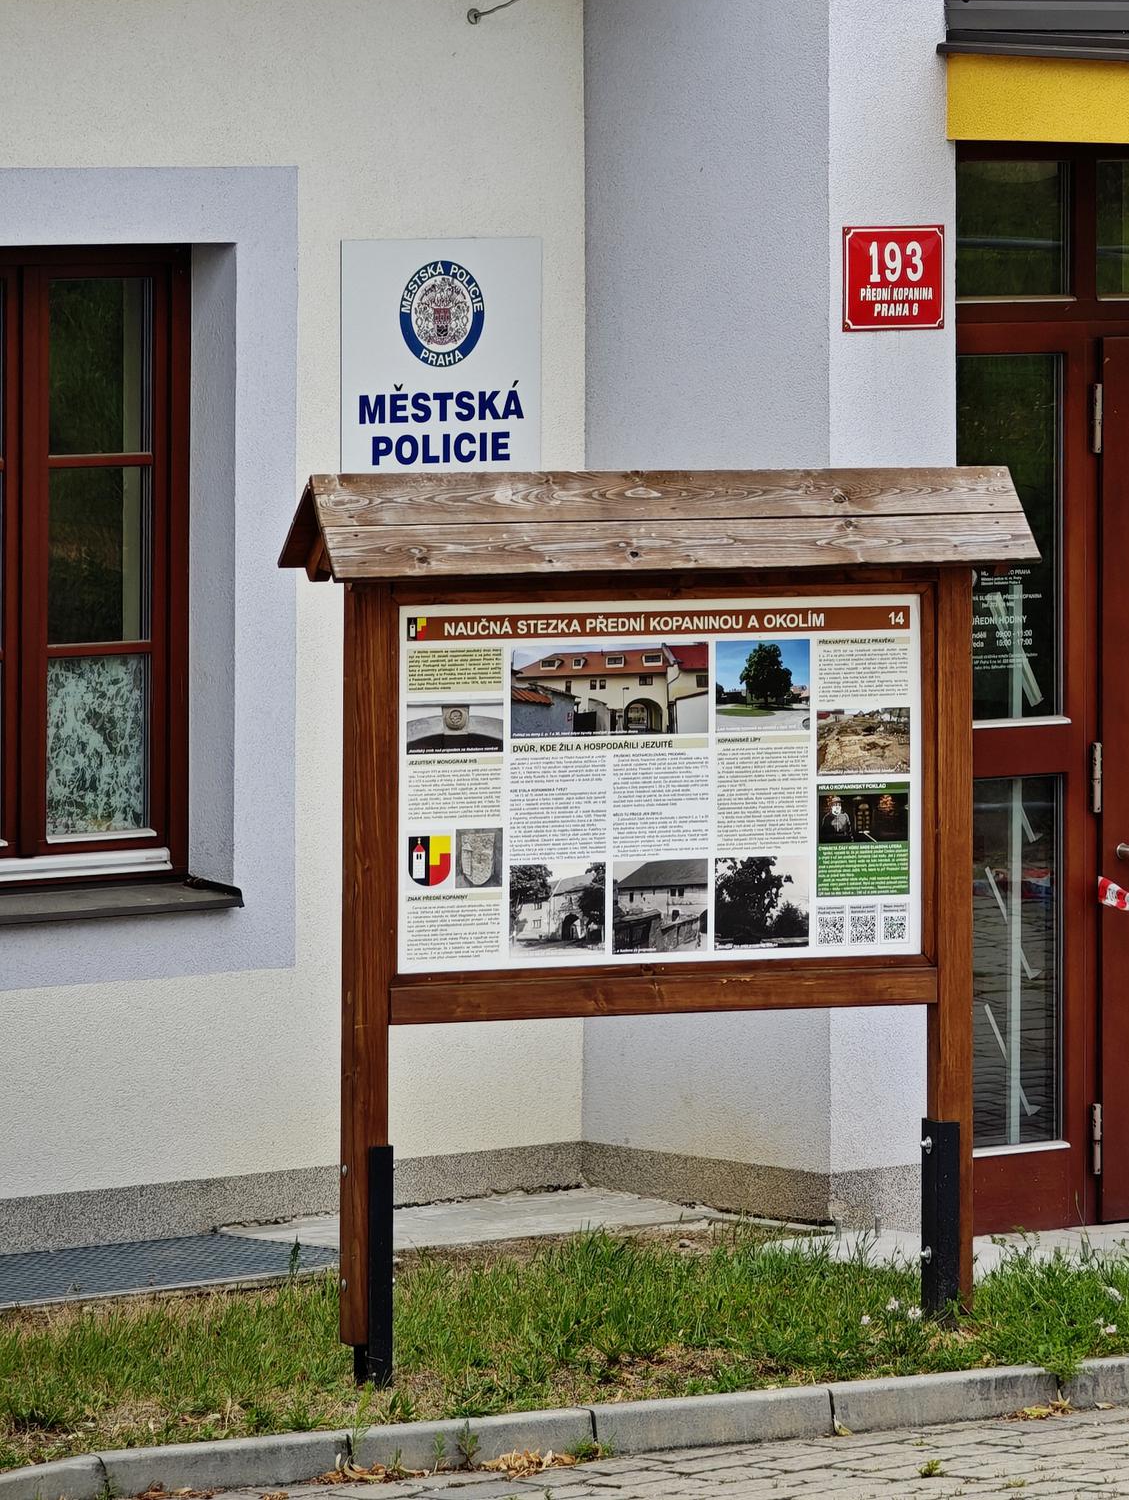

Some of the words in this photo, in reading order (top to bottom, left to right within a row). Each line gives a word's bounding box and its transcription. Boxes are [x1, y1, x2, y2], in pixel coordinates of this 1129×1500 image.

[868, 240, 924, 283] 193
[401, 261, 445, 314] MĚSTSKÁ
[449, 264, 484, 313] POLICIE
[860, 285, 892, 301] PŘEDNÍ
[893, 287, 933, 300] KOPANINA
[874, 303, 909, 317] PRAHA
[912, 303, 919, 316] 6
[419, 349, 463, 367] PRAHA
[359, 380, 524, 425] MĚSTSKÁ
[371, 431, 511, 466] POLICIE
[444, 617, 513, 637] NAUČNÁ
[517, 619, 582, 635] STEZKA
[586, 614, 645, 633] PŘEDNÍ
[650, 615, 743, 632] KOPANINOU
[747, 614, 760, 629] A
[763, 610, 825, 628] OKOLÍM
[888, 611, 905, 626] 14
[512, 742, 538, 753] DVŮR,
[540, 744, 557, 752] KDE
[559, 741, 574, 751] ŽILI
[575, 743, 581, 751] A
[584, 740, 639, 751] HOSPODAŘILI
[640, 739, 673, 749] JEZUITÉ
